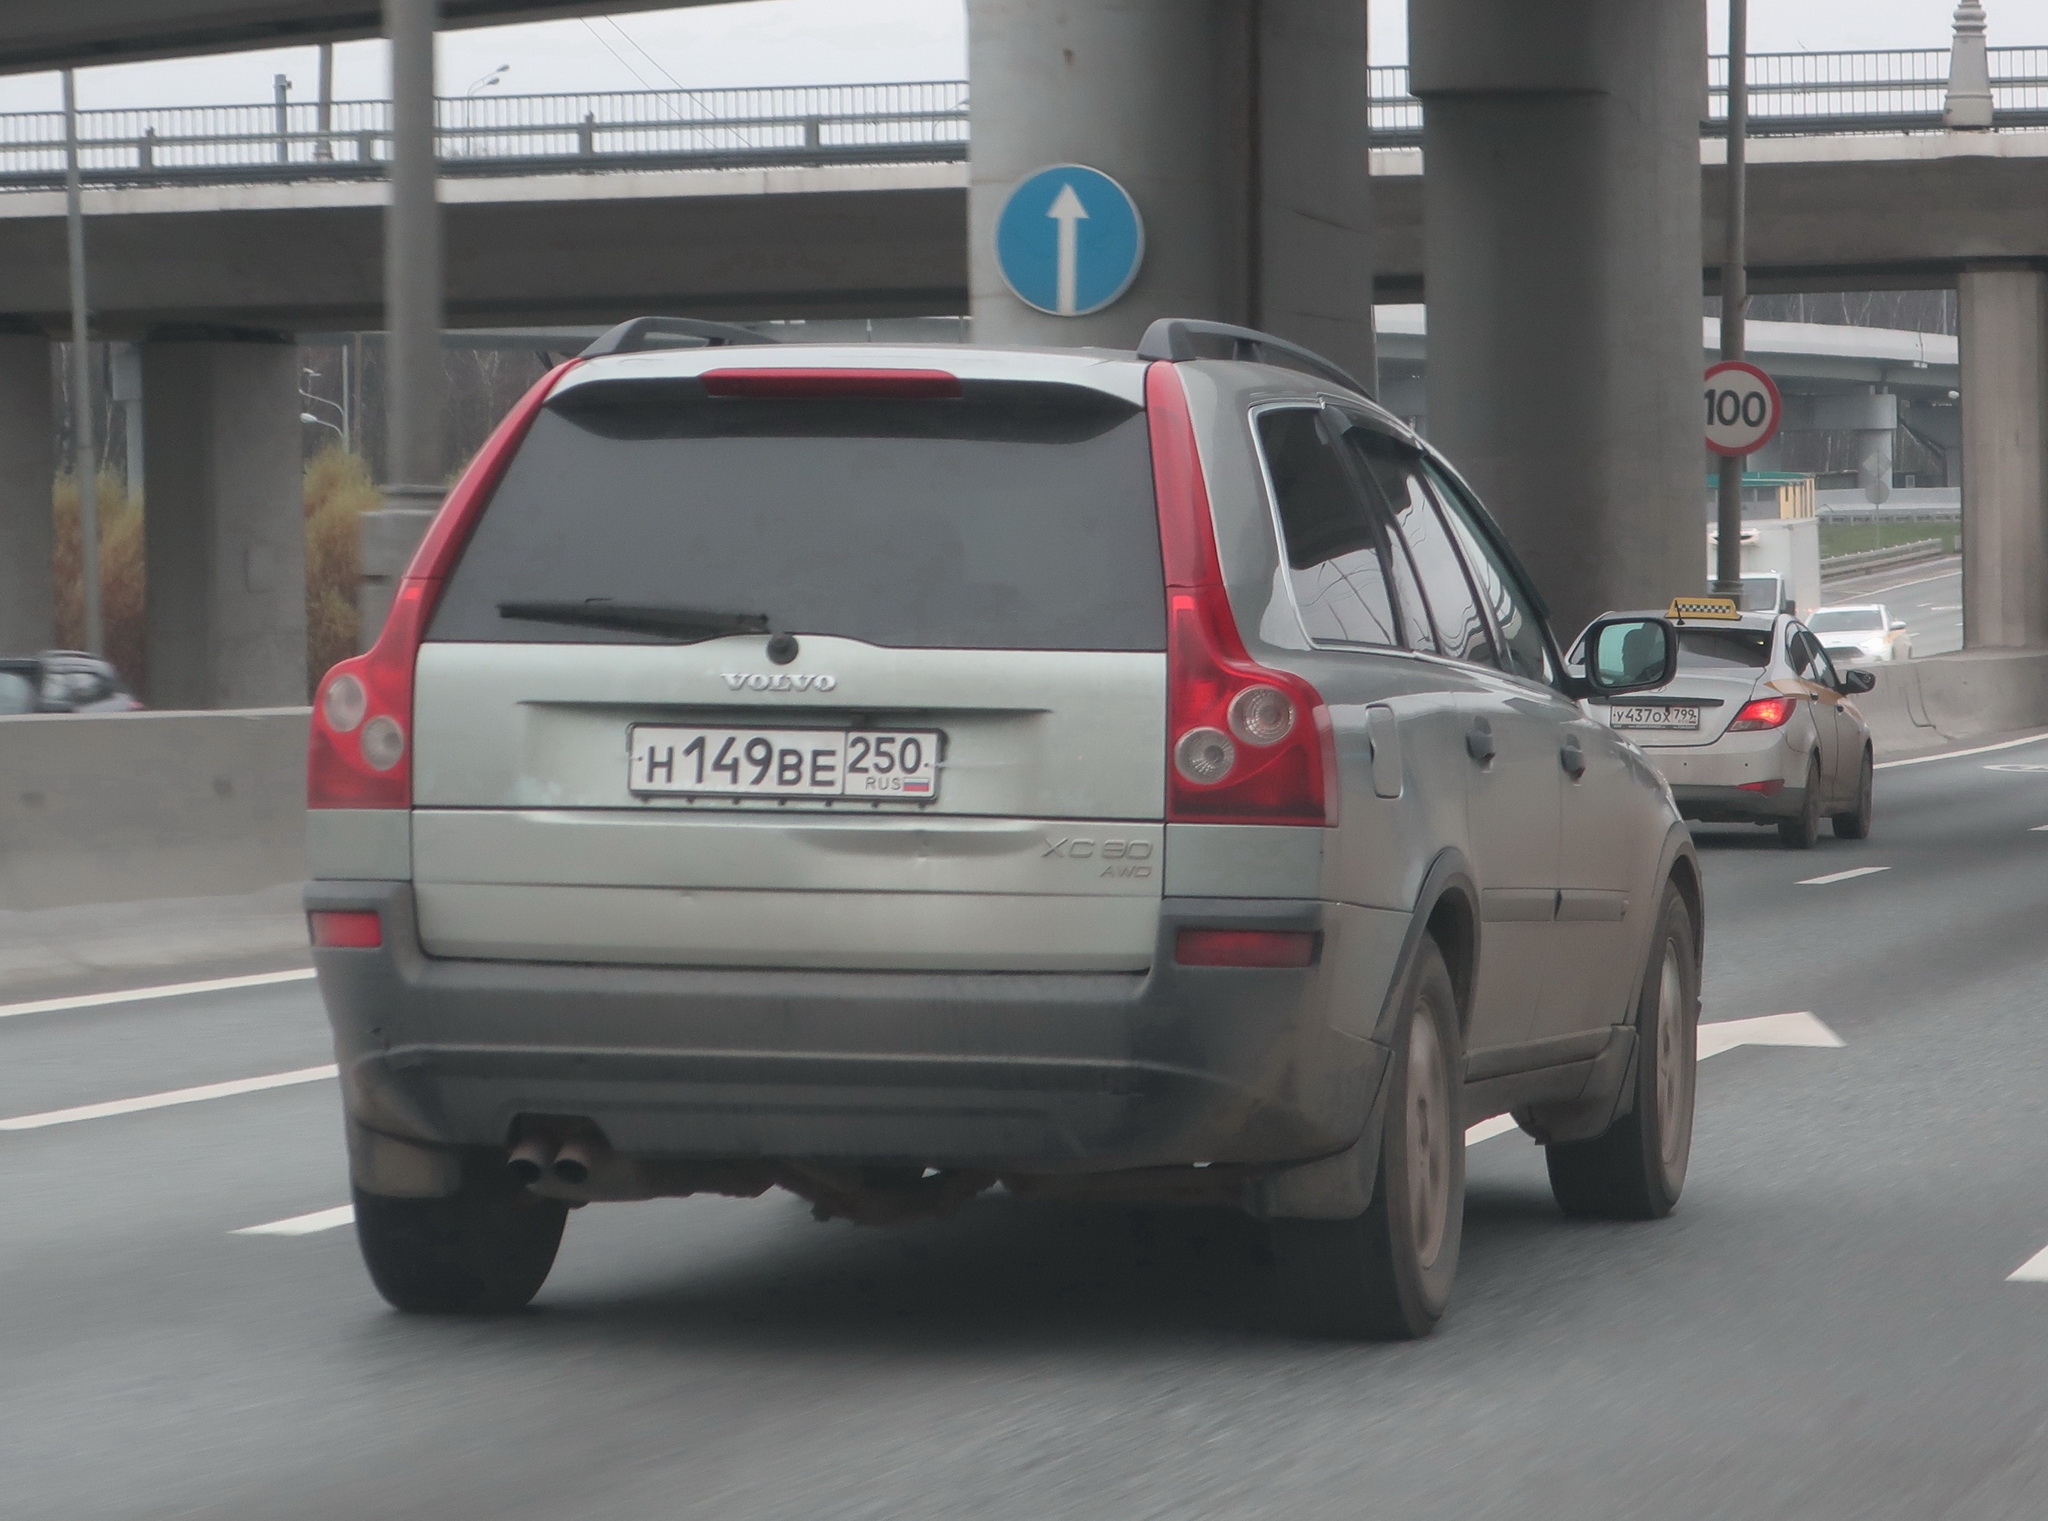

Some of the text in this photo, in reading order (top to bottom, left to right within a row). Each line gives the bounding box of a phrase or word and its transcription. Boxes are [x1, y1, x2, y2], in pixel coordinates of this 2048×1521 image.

[1704, 389, 1766, 427] 100
[720, 673, 837, 692] VOLVO
[1674, 709, 1695, 720] 799
[646, 736, 921, 787] Н149ВЕ 250
[865, 776, 900, 791] RUS
[1100, 865, 1151, 878] AWD
